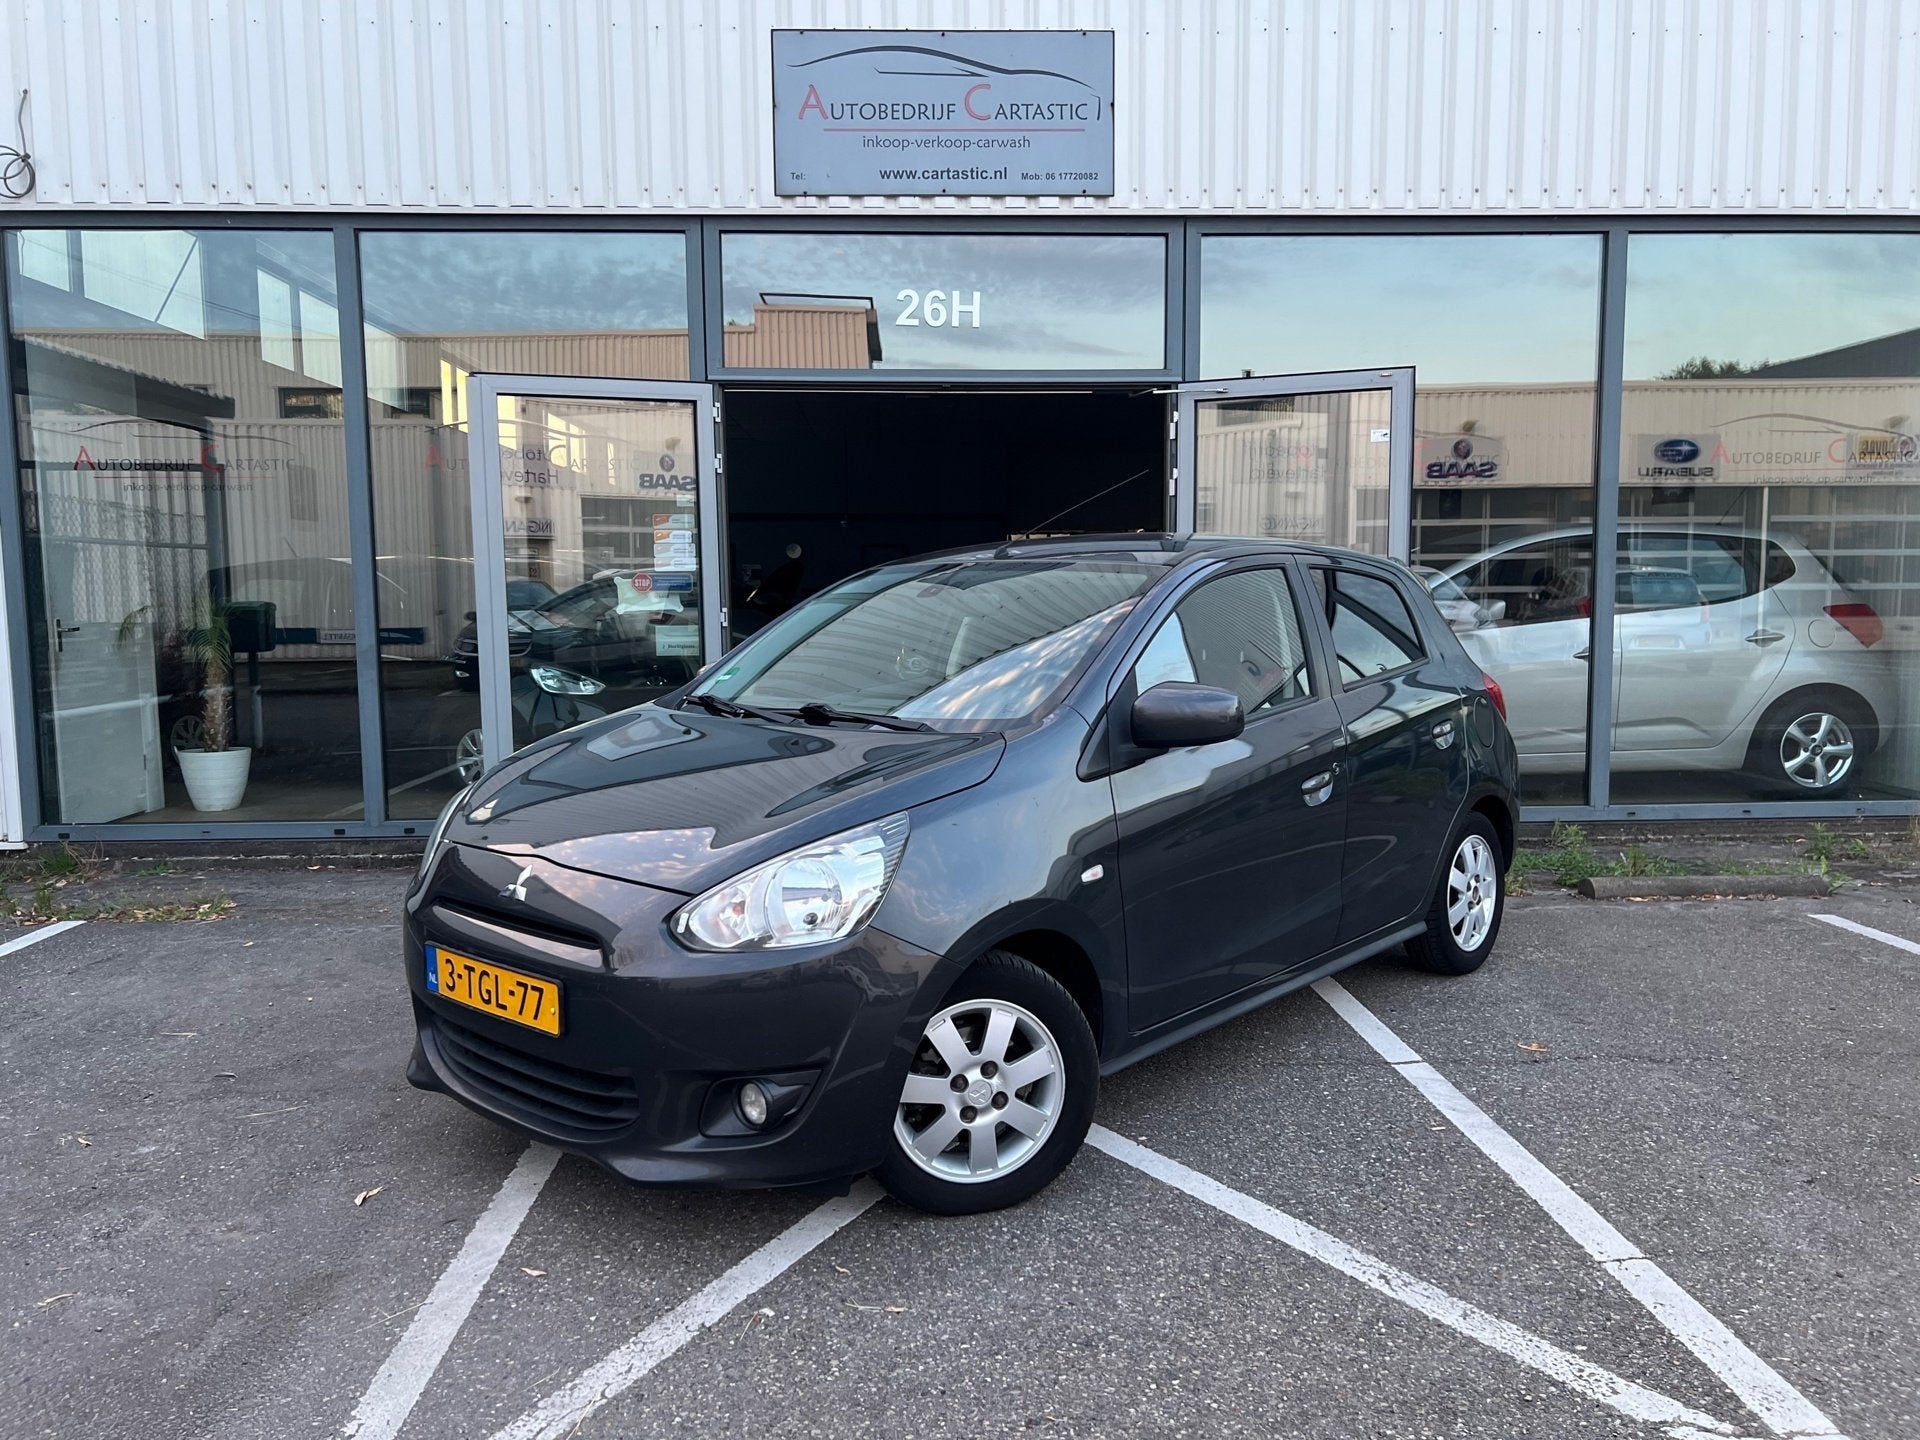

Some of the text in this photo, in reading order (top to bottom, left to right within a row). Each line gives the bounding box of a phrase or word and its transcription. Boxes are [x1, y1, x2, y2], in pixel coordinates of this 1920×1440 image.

[798, 83, 1089, 121] AUTOBEDRIJF CARTASTIC
[862, 135, 1032, 151] inkoop-verkoop-carwash
[790, 172, 807, 181] Tel:
[879, 166, 1009, 181] www.cartastic.nl
[1021, 171, 1099, 181] Mob: 06 17720082
[895, 288, 982, 329] 26H
[1708, 439, 1822, 465] AUTOBEDRIJF
[633, 577, 651, 588] STOP
[428, 971, 438, 984] NL
[444, 958, 545, 1021] 3-TGL-77
